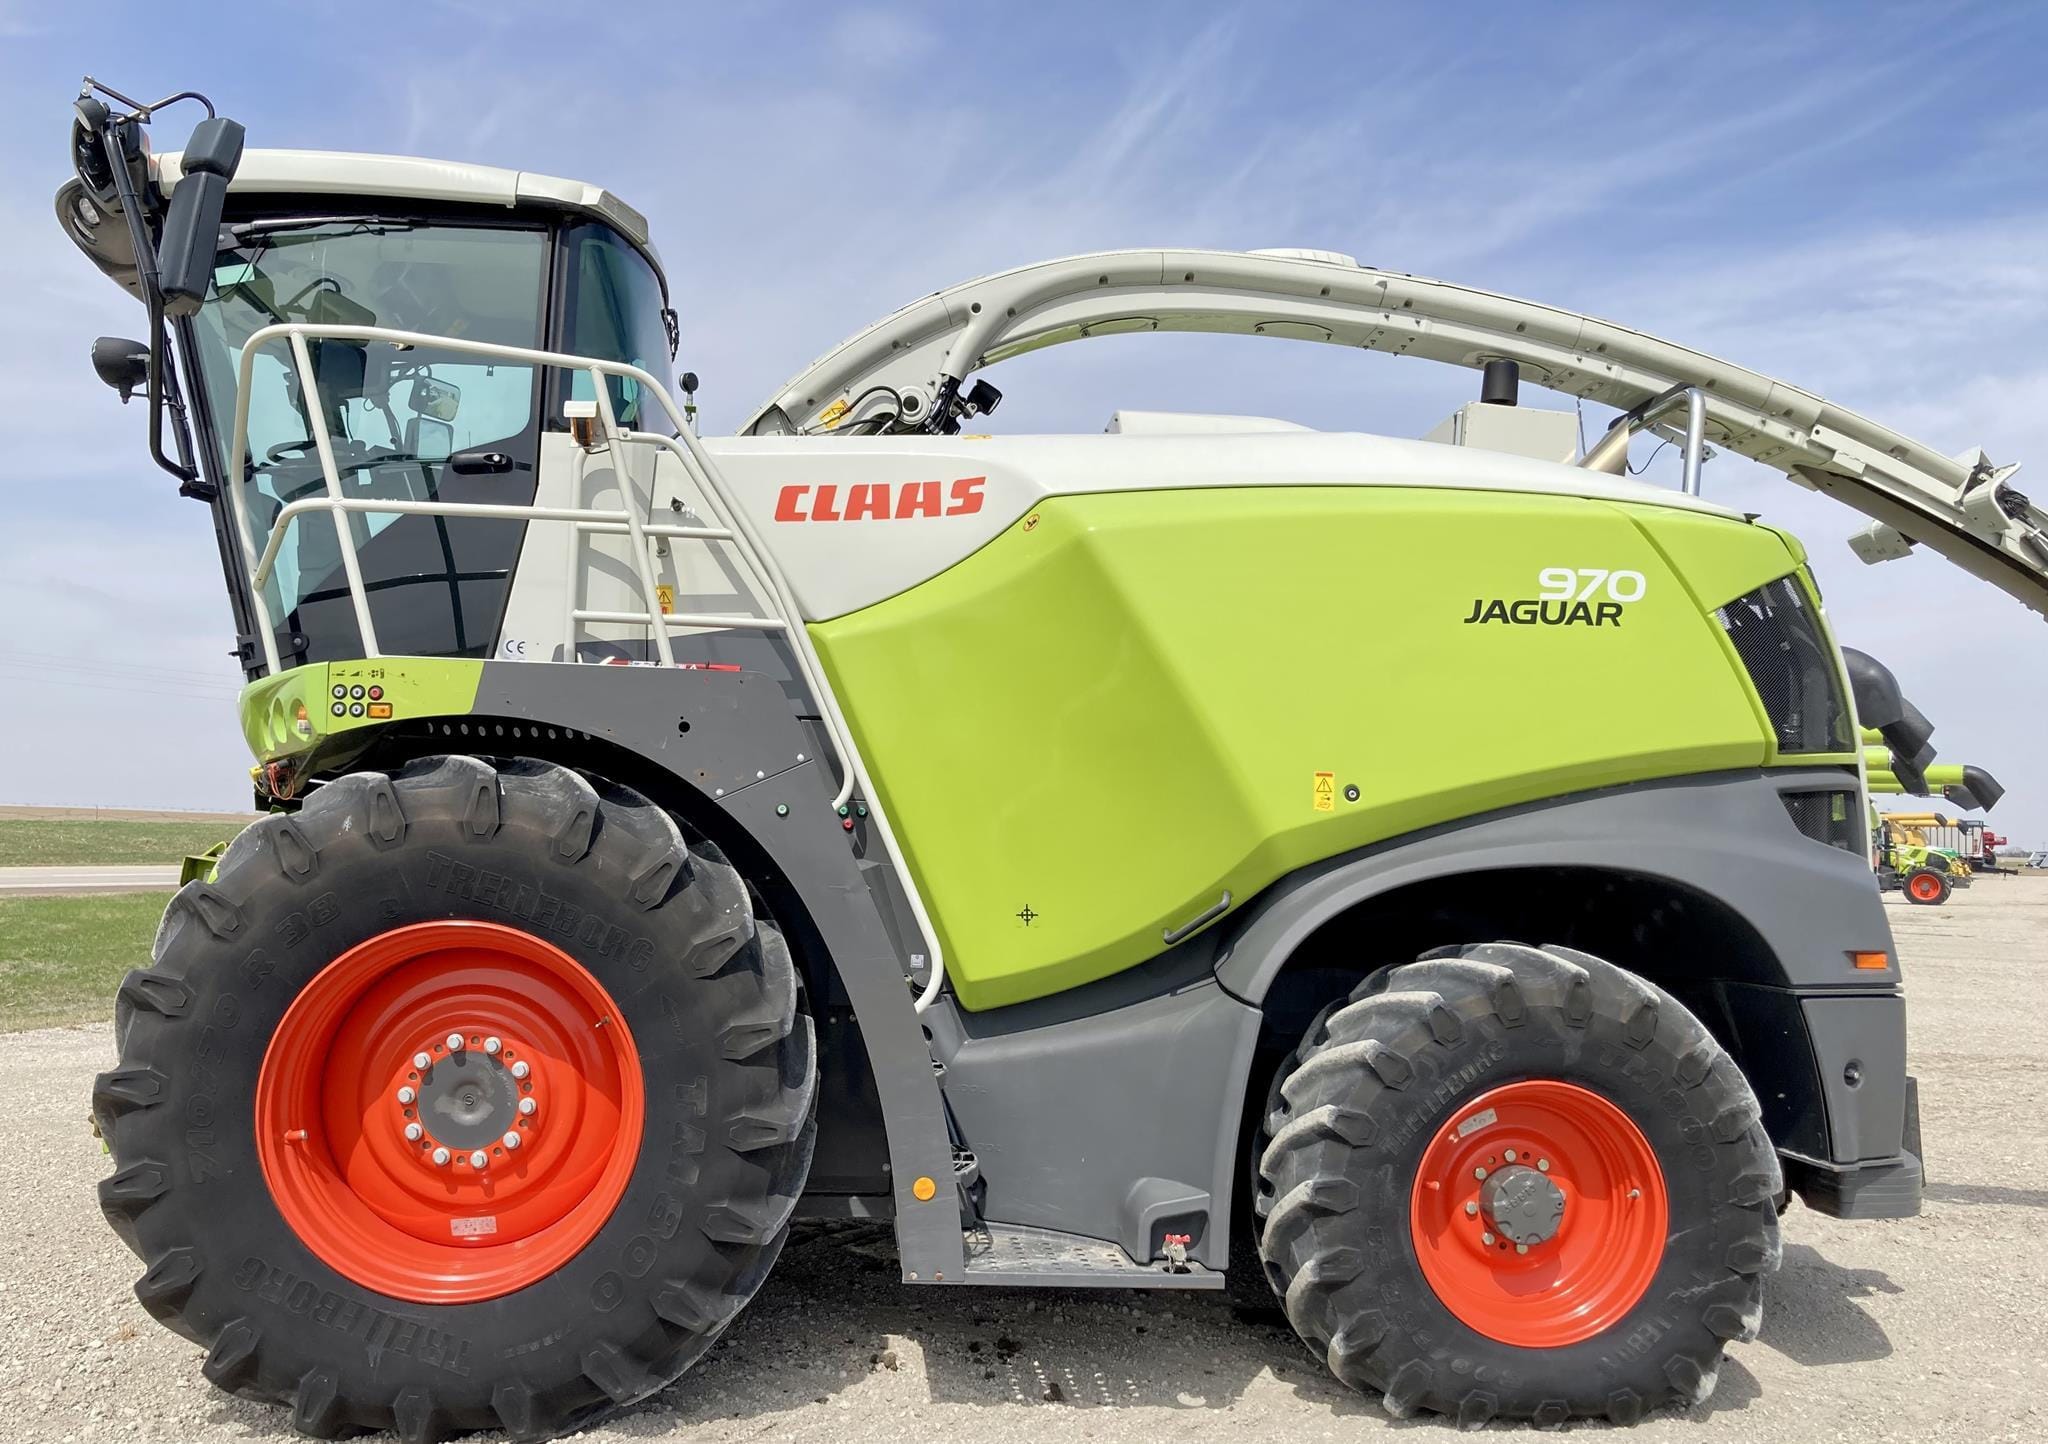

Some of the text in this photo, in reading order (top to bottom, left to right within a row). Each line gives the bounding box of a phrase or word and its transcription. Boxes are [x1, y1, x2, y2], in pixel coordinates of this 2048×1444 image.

[774, 476, 987, 523] CLAAS
[1539, 567, 1647, 603] 970
[1463, 599, 1624, 627] JAGUAR
[426, 850, 656, 974] TRELLEBORG
